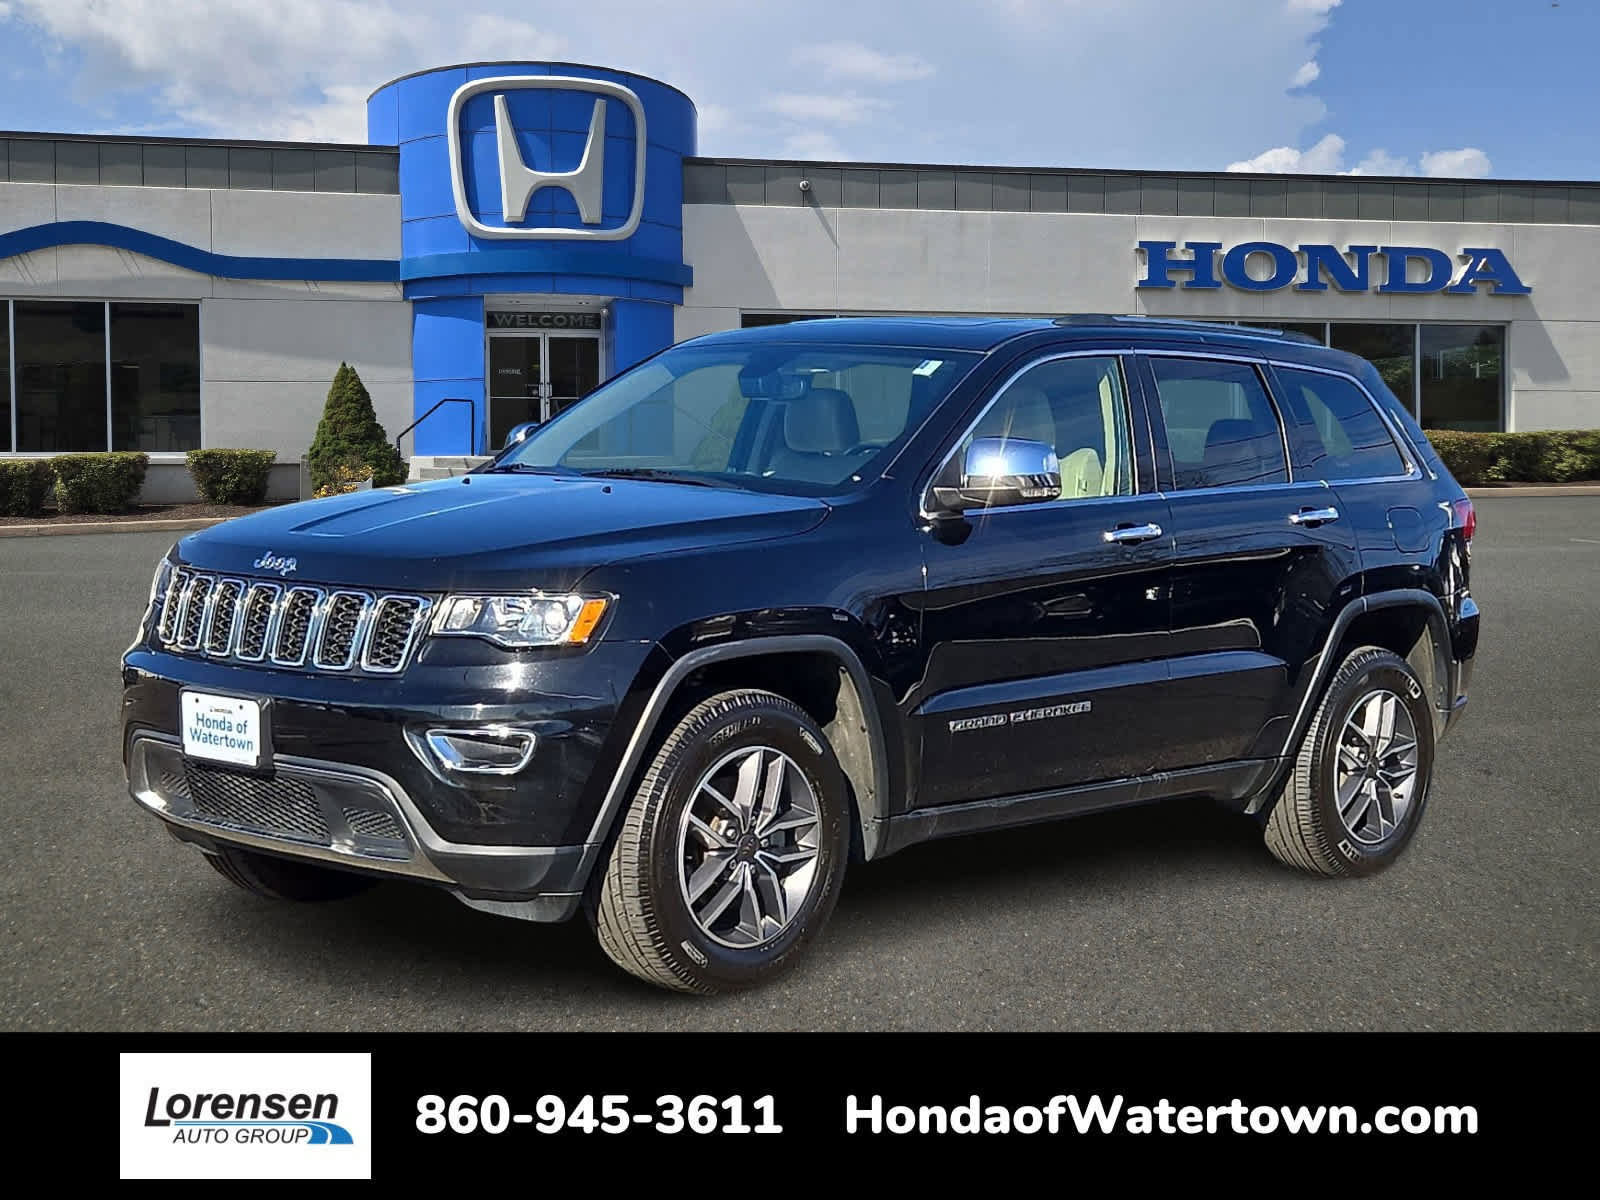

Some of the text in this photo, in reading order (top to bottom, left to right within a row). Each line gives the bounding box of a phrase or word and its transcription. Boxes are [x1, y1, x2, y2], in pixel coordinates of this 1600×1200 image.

[494, 95, 606, 224] H
[1136, 240, 1532, 294] HONDA
[494, 313, 594, 327] WELCOME
[253, 551, 297, 577] Jeep
[196, 712, 248, 735] Honda of
[949, 701, 1092, 733] GRAND CHEROKEE
[190, 727, 254, 752] Watertown
